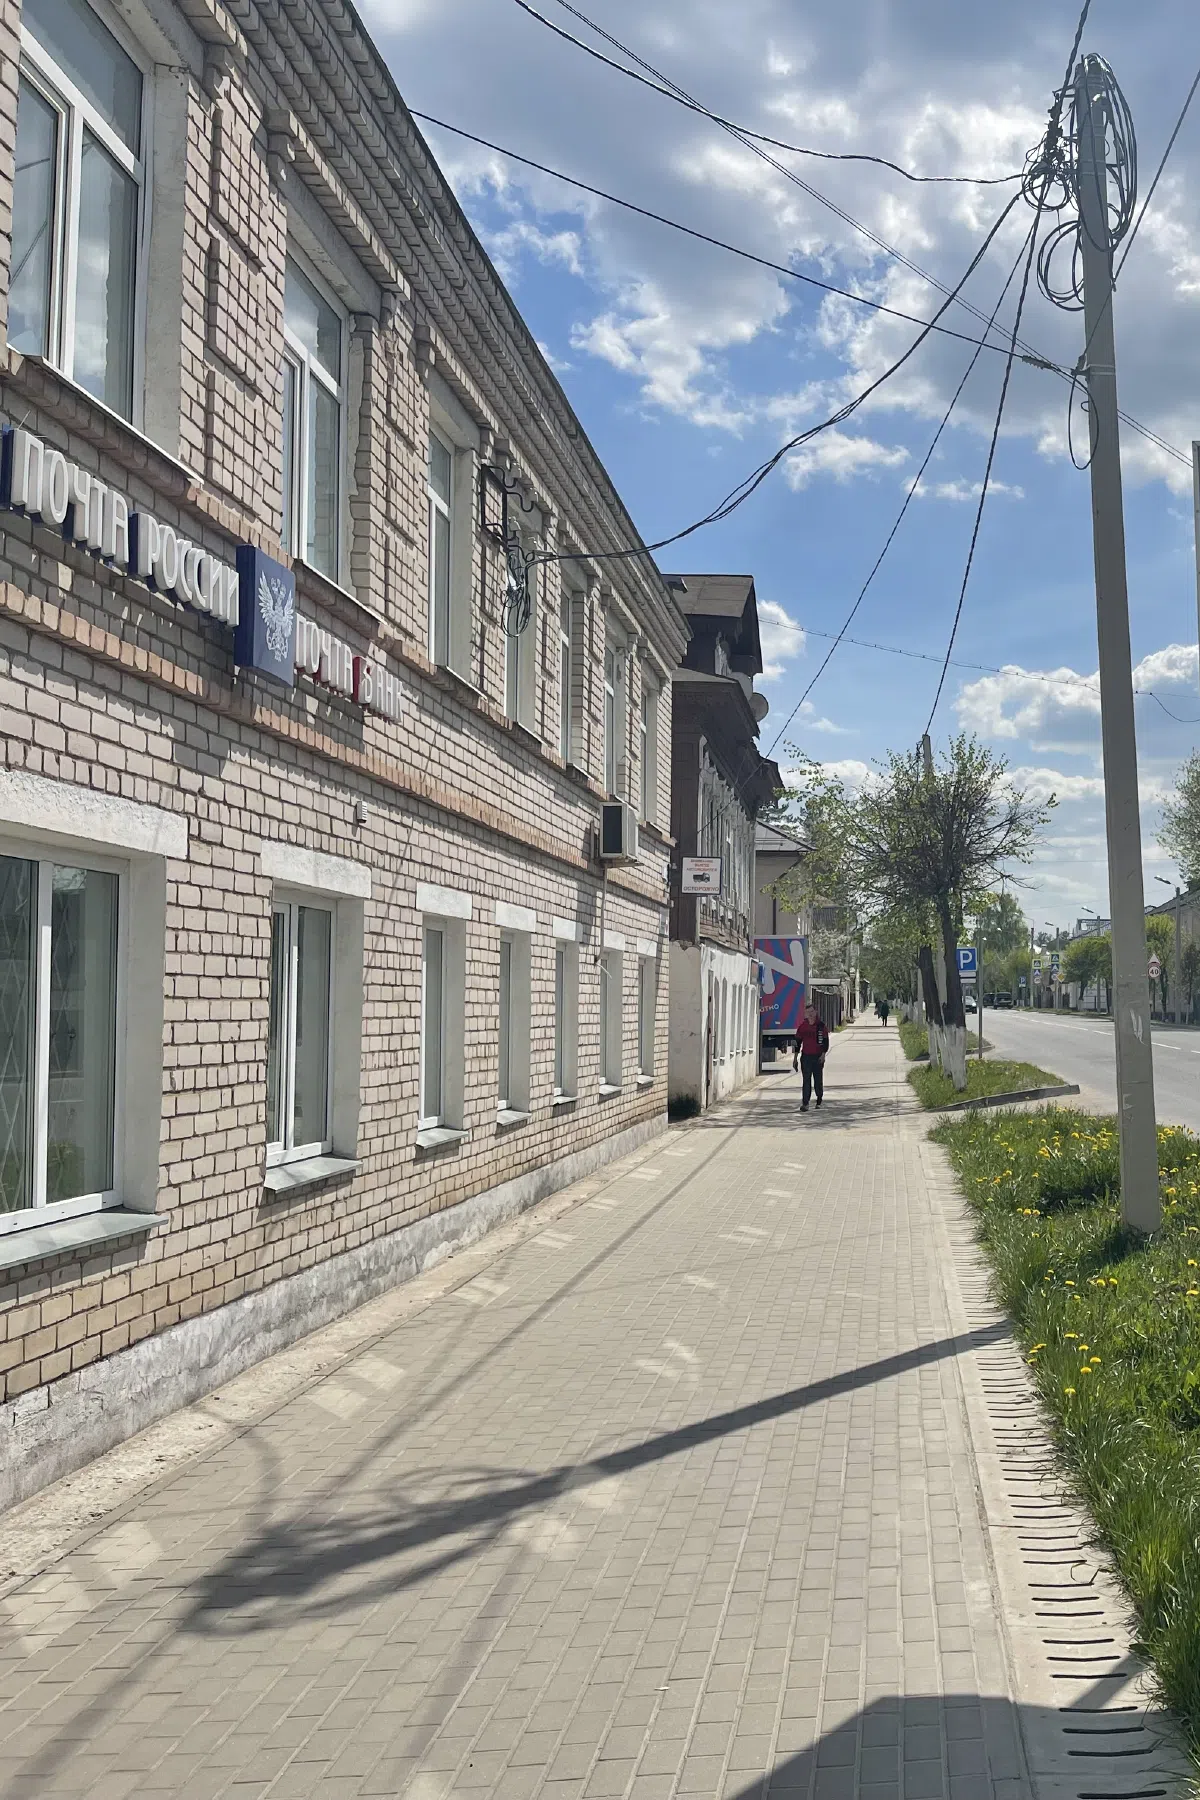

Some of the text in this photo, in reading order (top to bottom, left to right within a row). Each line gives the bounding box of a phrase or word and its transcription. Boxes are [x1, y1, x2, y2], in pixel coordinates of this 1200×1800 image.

[12, 429, 239, 627] ПОЧТА РОССИИ
[296, 613, 403, 722] ПОЧТА БАНК
